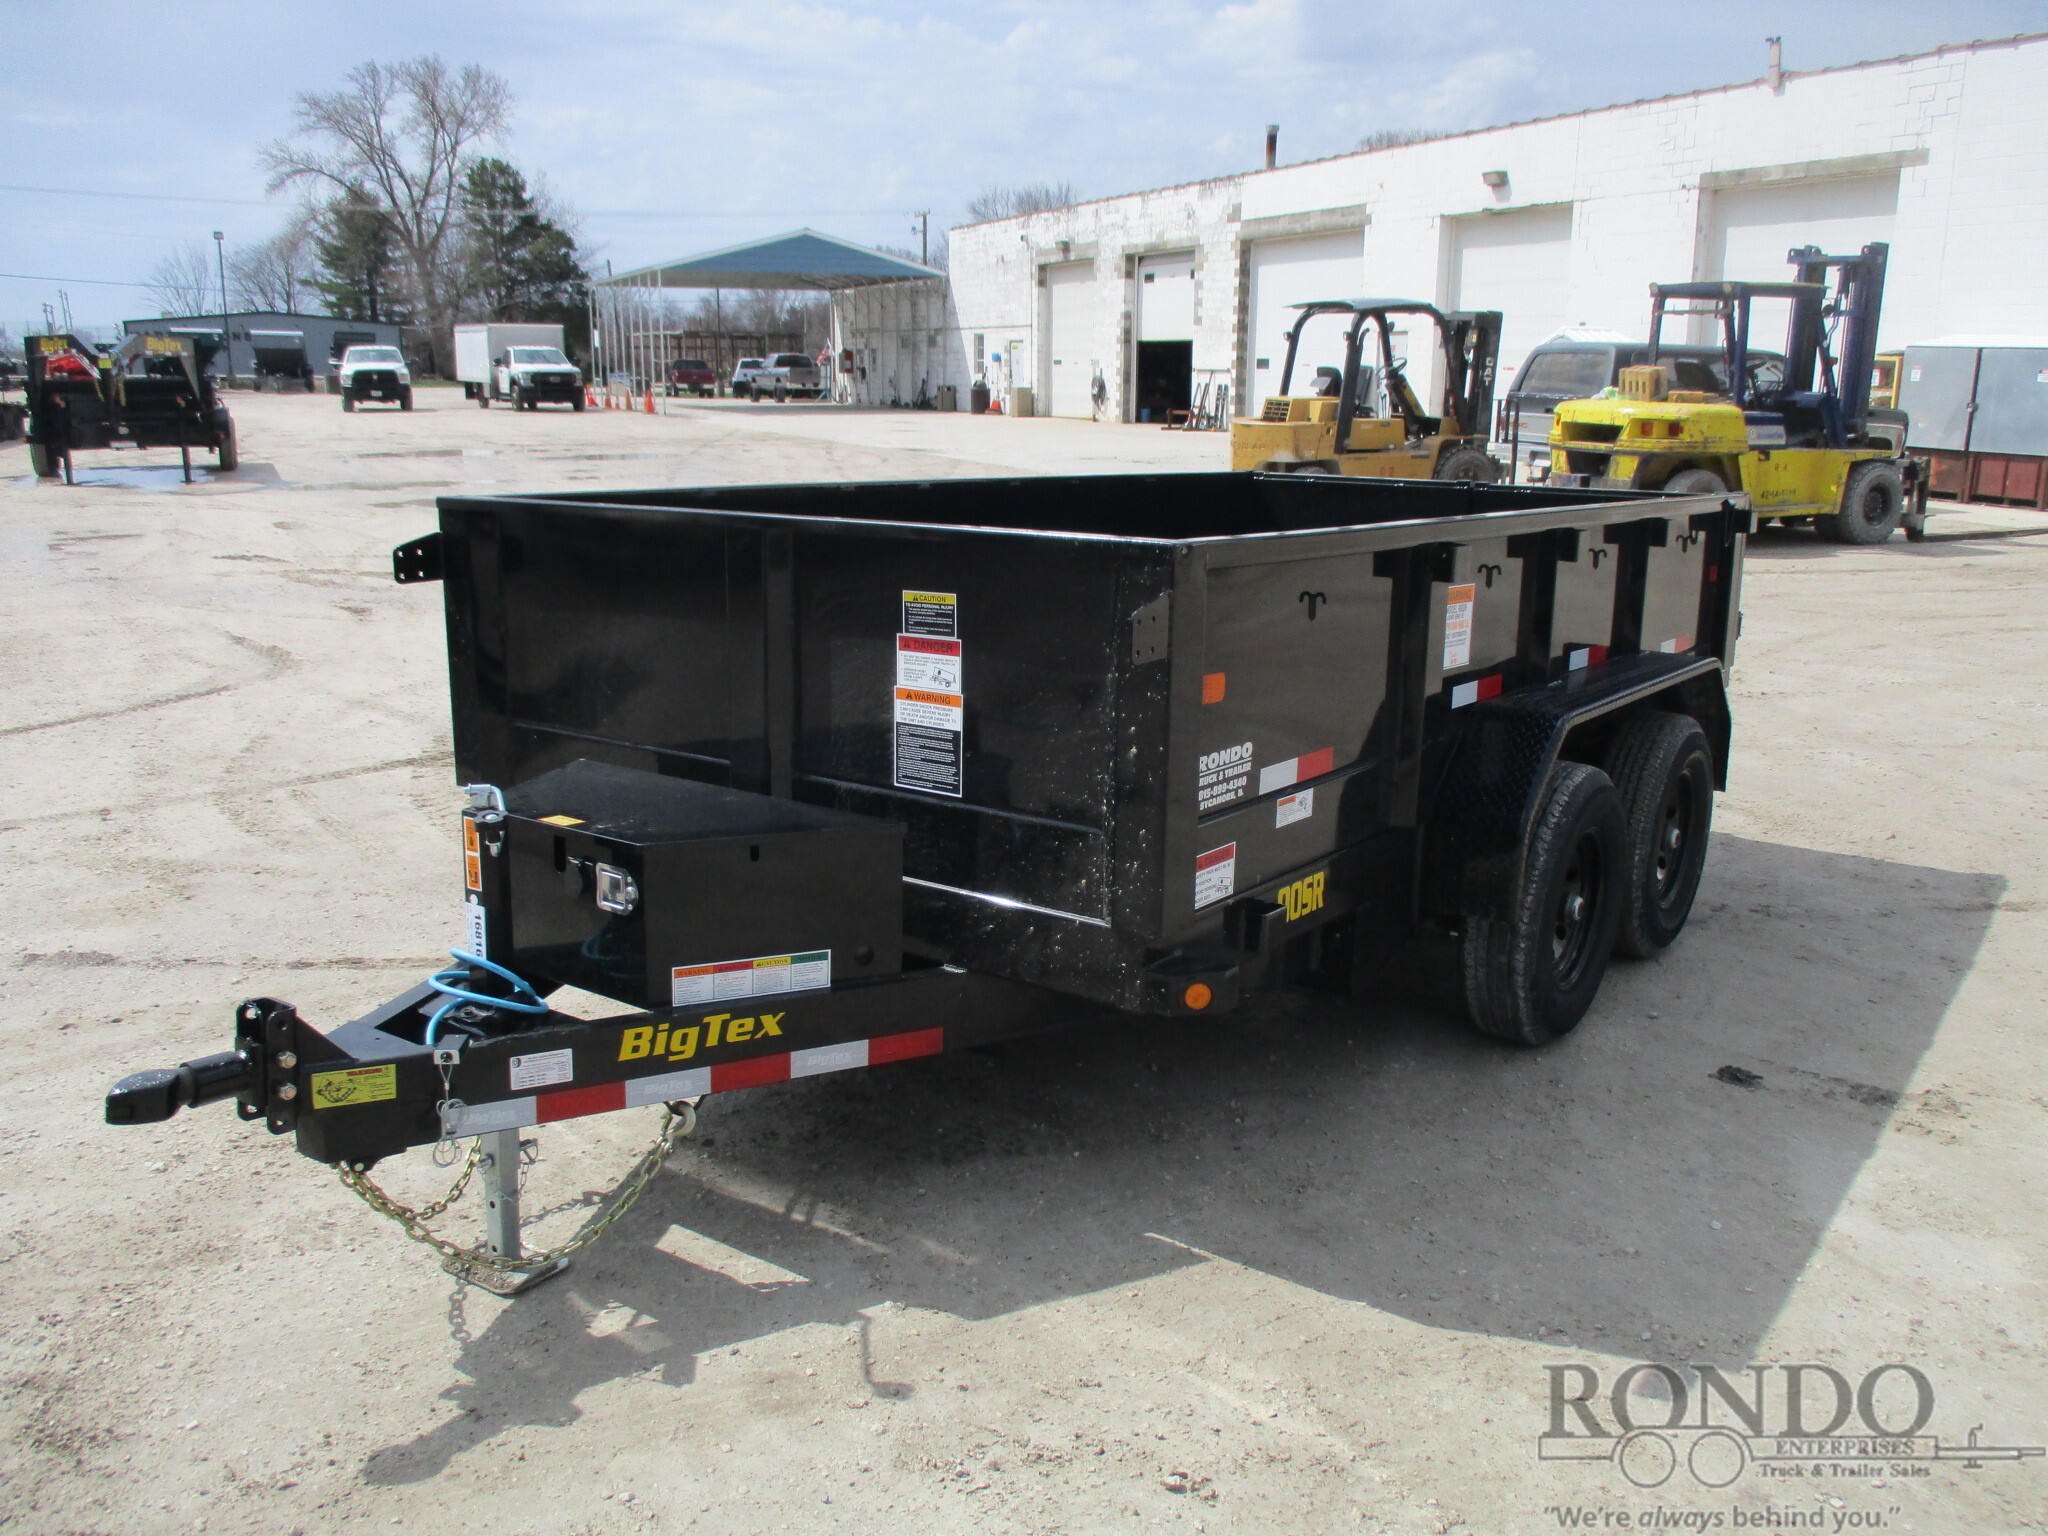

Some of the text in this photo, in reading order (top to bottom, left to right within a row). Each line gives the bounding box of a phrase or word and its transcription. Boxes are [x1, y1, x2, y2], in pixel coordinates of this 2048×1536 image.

[1483, 356, 1495, 386] CAT
[919, 594, 946, 603] CAUTION
[914, 640, 953, 653] DANGER
[914, 692, 951, 704] WARNING
[1200, 742, 1253, 772] RONDO
[1199, 762, 1251, 787] RUCK & TRAILER
[761, 959, 788, 967] CAUTION
[677, 967, 710, 977] WARNING
[618, 1012, 786, 1062] BigTex
